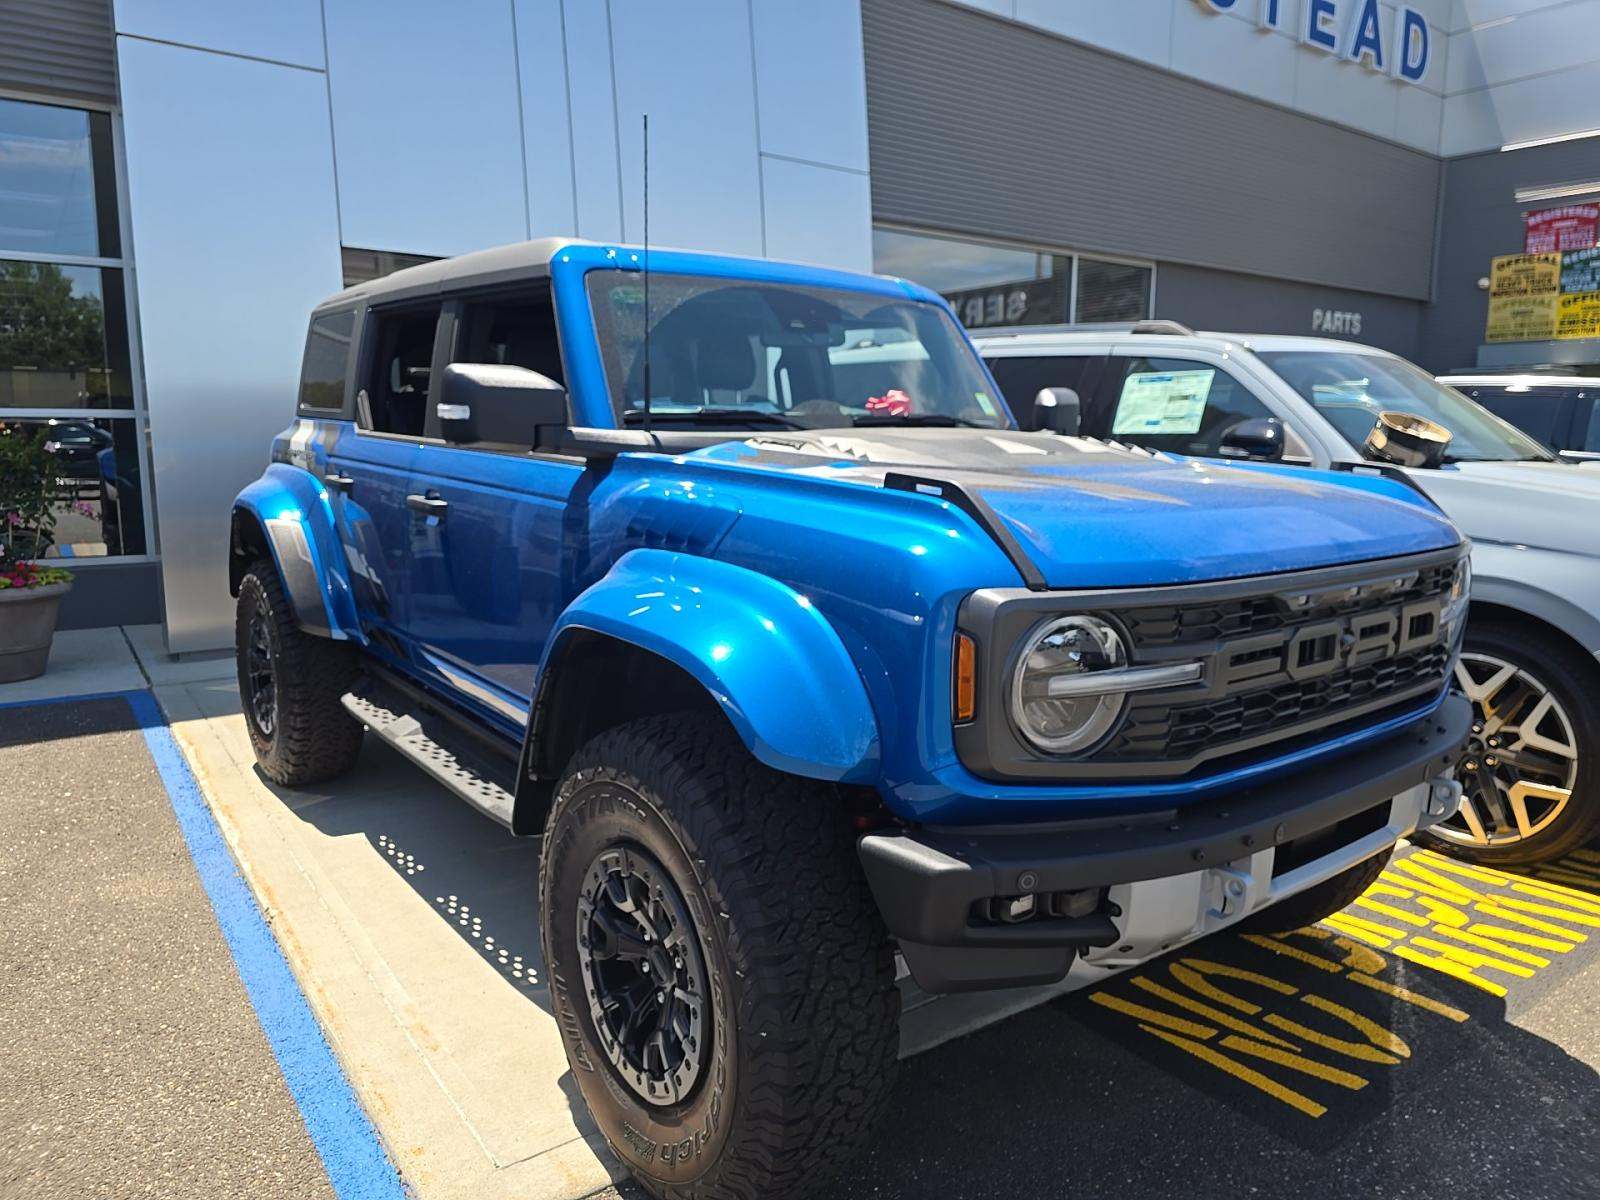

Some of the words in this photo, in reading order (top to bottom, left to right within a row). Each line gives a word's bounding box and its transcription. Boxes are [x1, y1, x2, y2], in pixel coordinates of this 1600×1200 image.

[1312, 308, 1361, 335] PARTS
[1207, 601, 1442, 698] FORD
[1089, 957, 1411, 1119] NO
